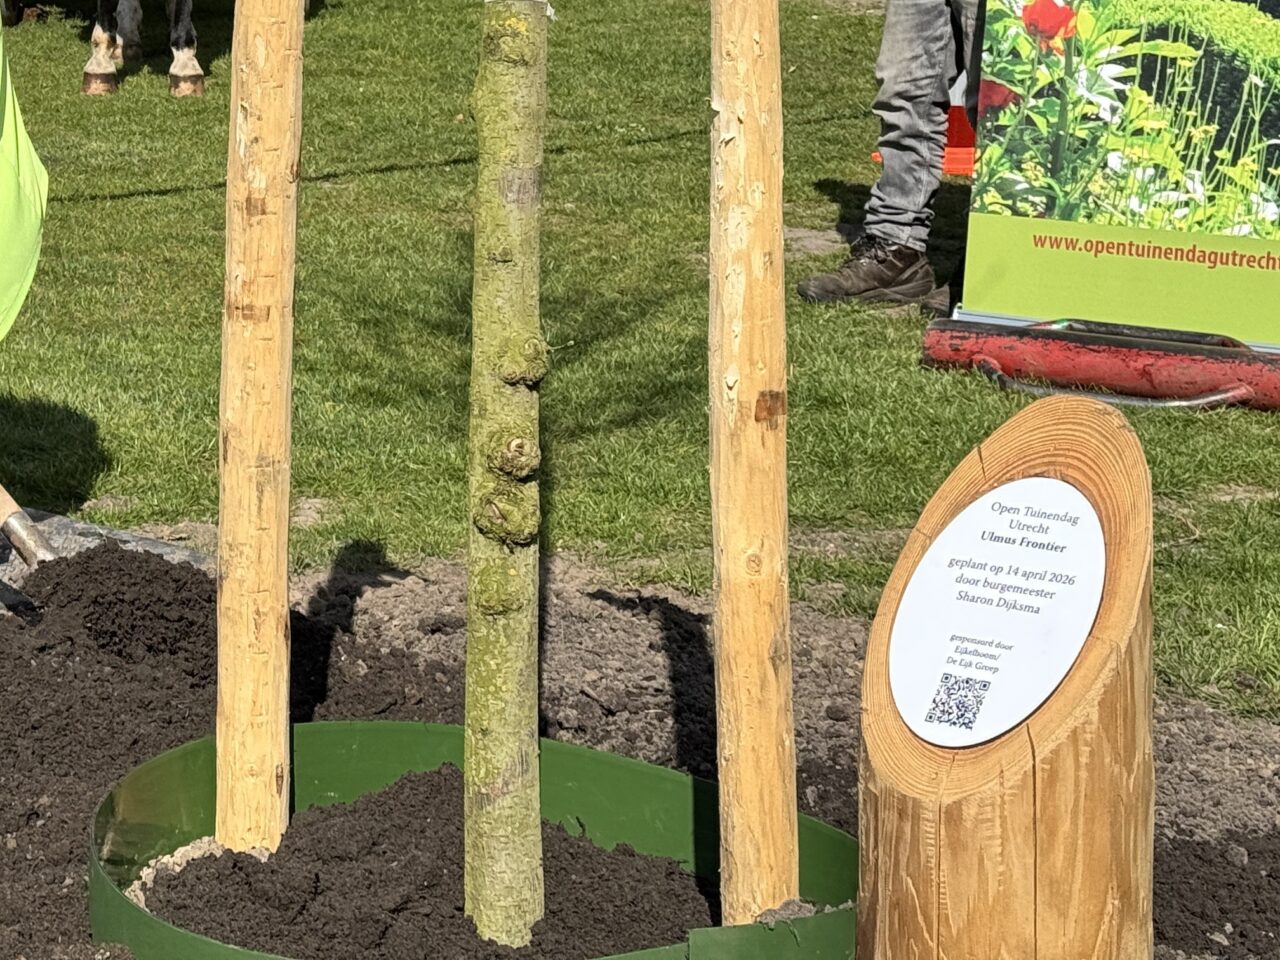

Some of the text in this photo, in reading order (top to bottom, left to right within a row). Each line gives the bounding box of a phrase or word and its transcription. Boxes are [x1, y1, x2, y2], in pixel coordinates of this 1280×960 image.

[1032, 234, 1280, 271] www.opentuinendagutrech
[991, 501, 1080, 527] Open Tuinendag
[1008, 519, 1050, 535] Utrecht
[980, 530, 1067, 553] Ulmus Frontier
[947, 557, 1076, 586] geplant op 14 april 2026
[955, 573, 1056, 600] door burgemeester
[956, 590, 1041, 615] Sharon Dijksma
[994, 641, 1014, 651] door
[975, 661, 1000, 675] Groep
